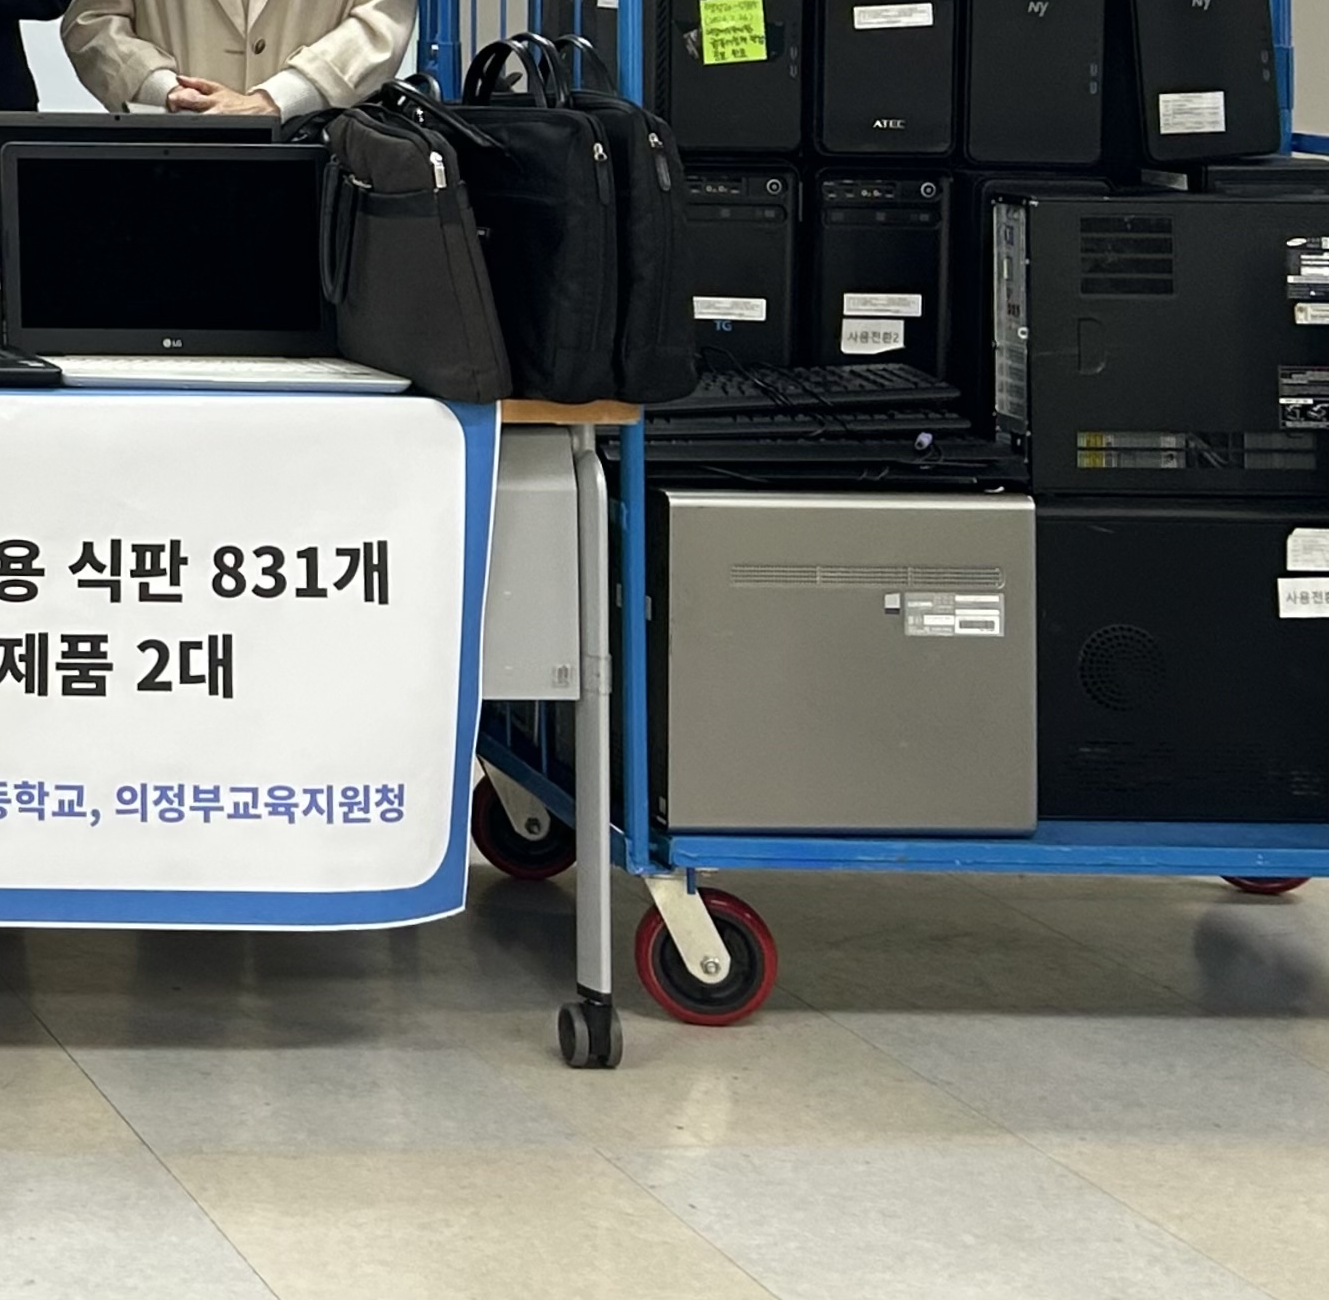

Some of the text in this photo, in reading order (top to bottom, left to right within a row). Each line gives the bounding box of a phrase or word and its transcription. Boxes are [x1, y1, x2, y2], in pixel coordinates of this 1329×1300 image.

[873, 119, 902, 128] ATEC
[714, 320, 733, 332] TG
[67, 538, 189, 604] 식판
[211, 539, 389, 606] 831개
[136, 633, 234, 700] 2대
[115, 782, 405, 825] 의정부교육지원청
